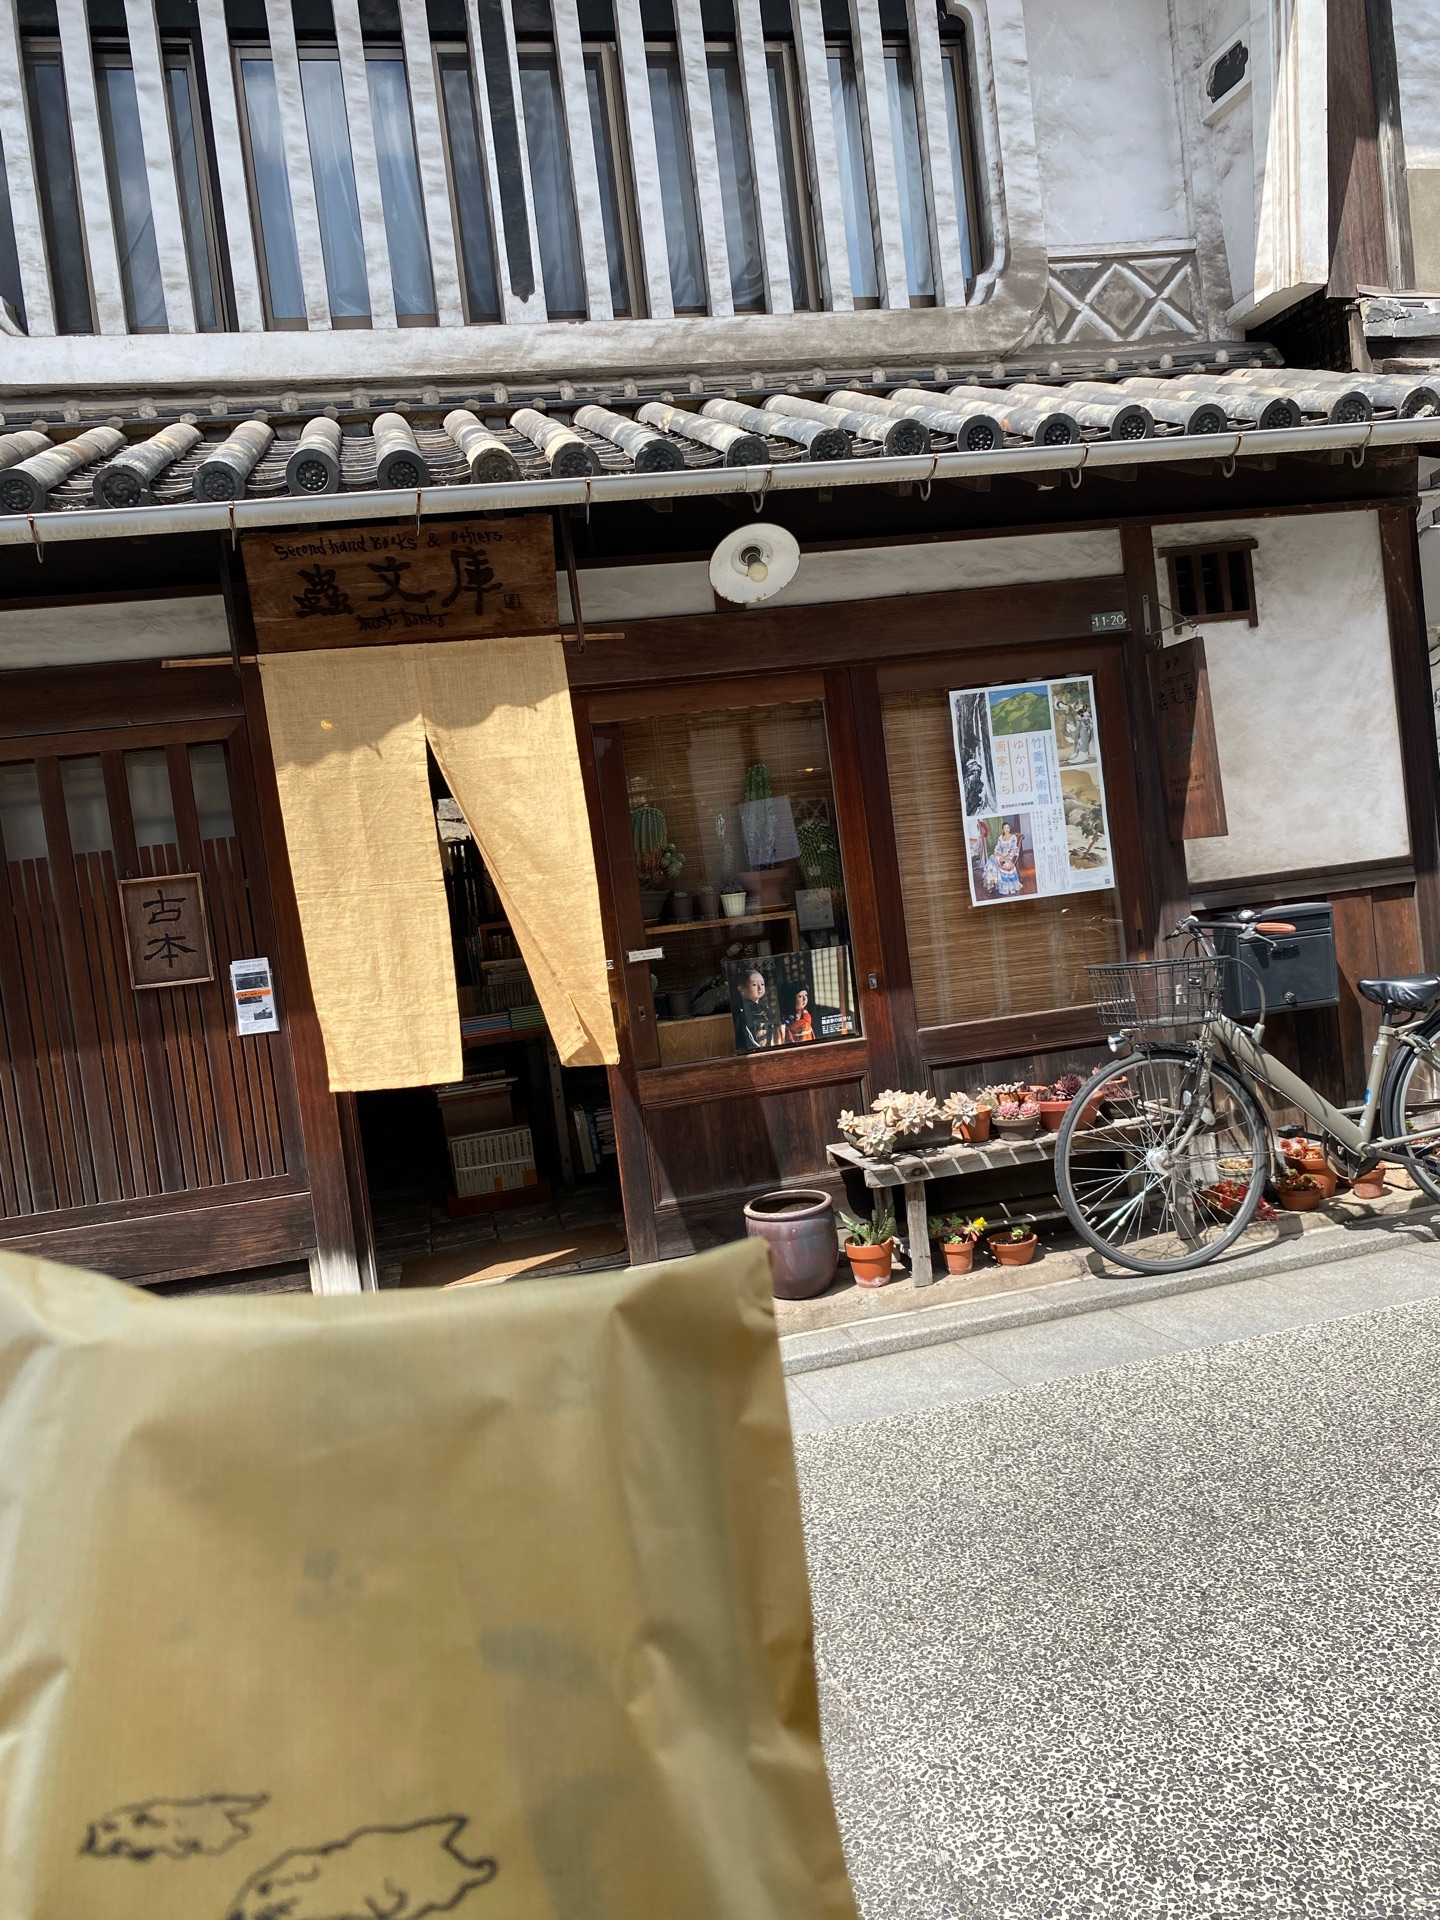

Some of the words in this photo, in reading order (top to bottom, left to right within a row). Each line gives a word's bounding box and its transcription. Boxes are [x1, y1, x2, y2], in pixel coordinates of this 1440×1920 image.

[427, 533, 441, 547] &
[293, 547, 503, 619] 蟲文庫
[995, 740, 1011, 795] 画家たち
[1013, 740, 1029, 792] ゆかりの
[1031, 736, 1049, 805] 竹喬美術館
[143, 889, 198, 968] 古本
